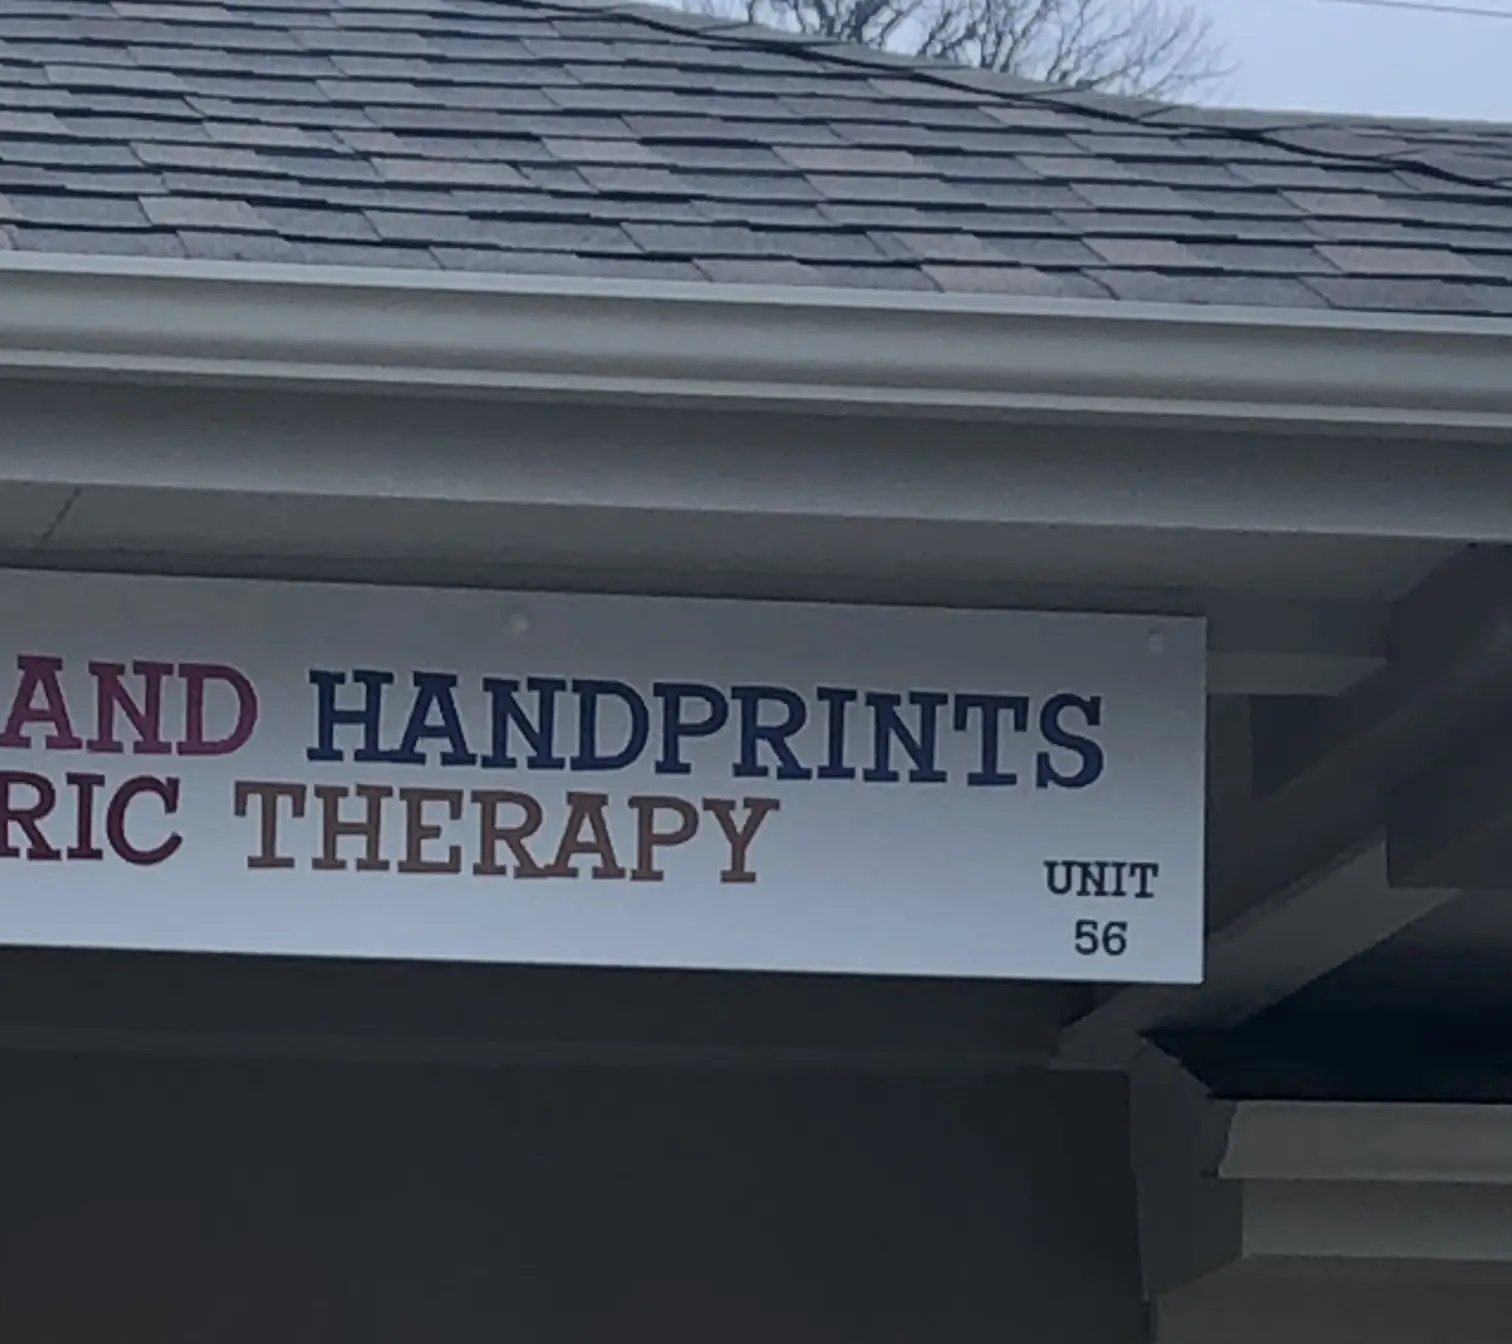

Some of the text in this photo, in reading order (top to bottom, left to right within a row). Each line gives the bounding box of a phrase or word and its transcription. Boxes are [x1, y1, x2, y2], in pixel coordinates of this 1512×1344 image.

[305, 667, 1105, 791] HANDPRINTS
[232, 779, 782, 885] THERAPY
[1042, 859, 1161, 900] UNIT
[1074, 918, 1129, 957] 56
